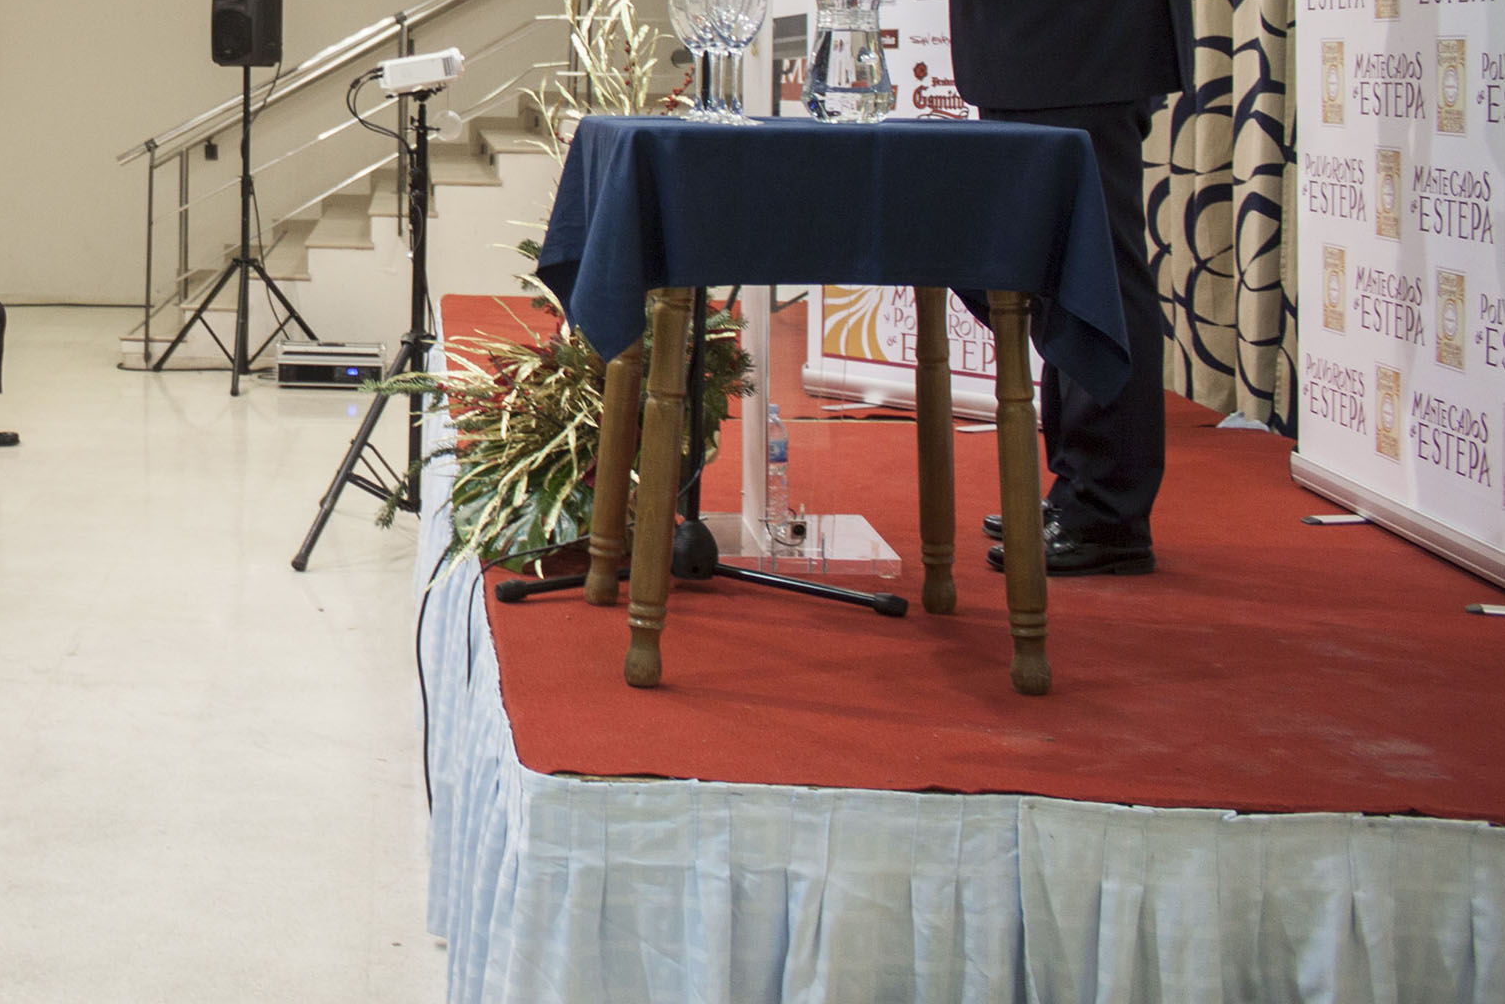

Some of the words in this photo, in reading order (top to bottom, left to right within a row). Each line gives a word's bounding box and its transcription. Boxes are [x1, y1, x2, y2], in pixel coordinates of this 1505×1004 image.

[1354, 51, 1423, 80] MANTECADOS
[1360, 81, 1425, 119] ESTEPA
[1309, 180, 1367, 222] ESTEPA
[1412, 165, 1491, 202] MANTECADOS
[1419, 195, 1494, 244] ESTEPA
[1356, 266, 1423, 306] MANTECADOS
[1361, 295, 1425, 346] ESTEPA
[1310, 380, 1367, 436] ESTEPA
[1411, 391, 1489, 443] MANTECADOS
[1417, 422, 1491, 487] ESTEPA
